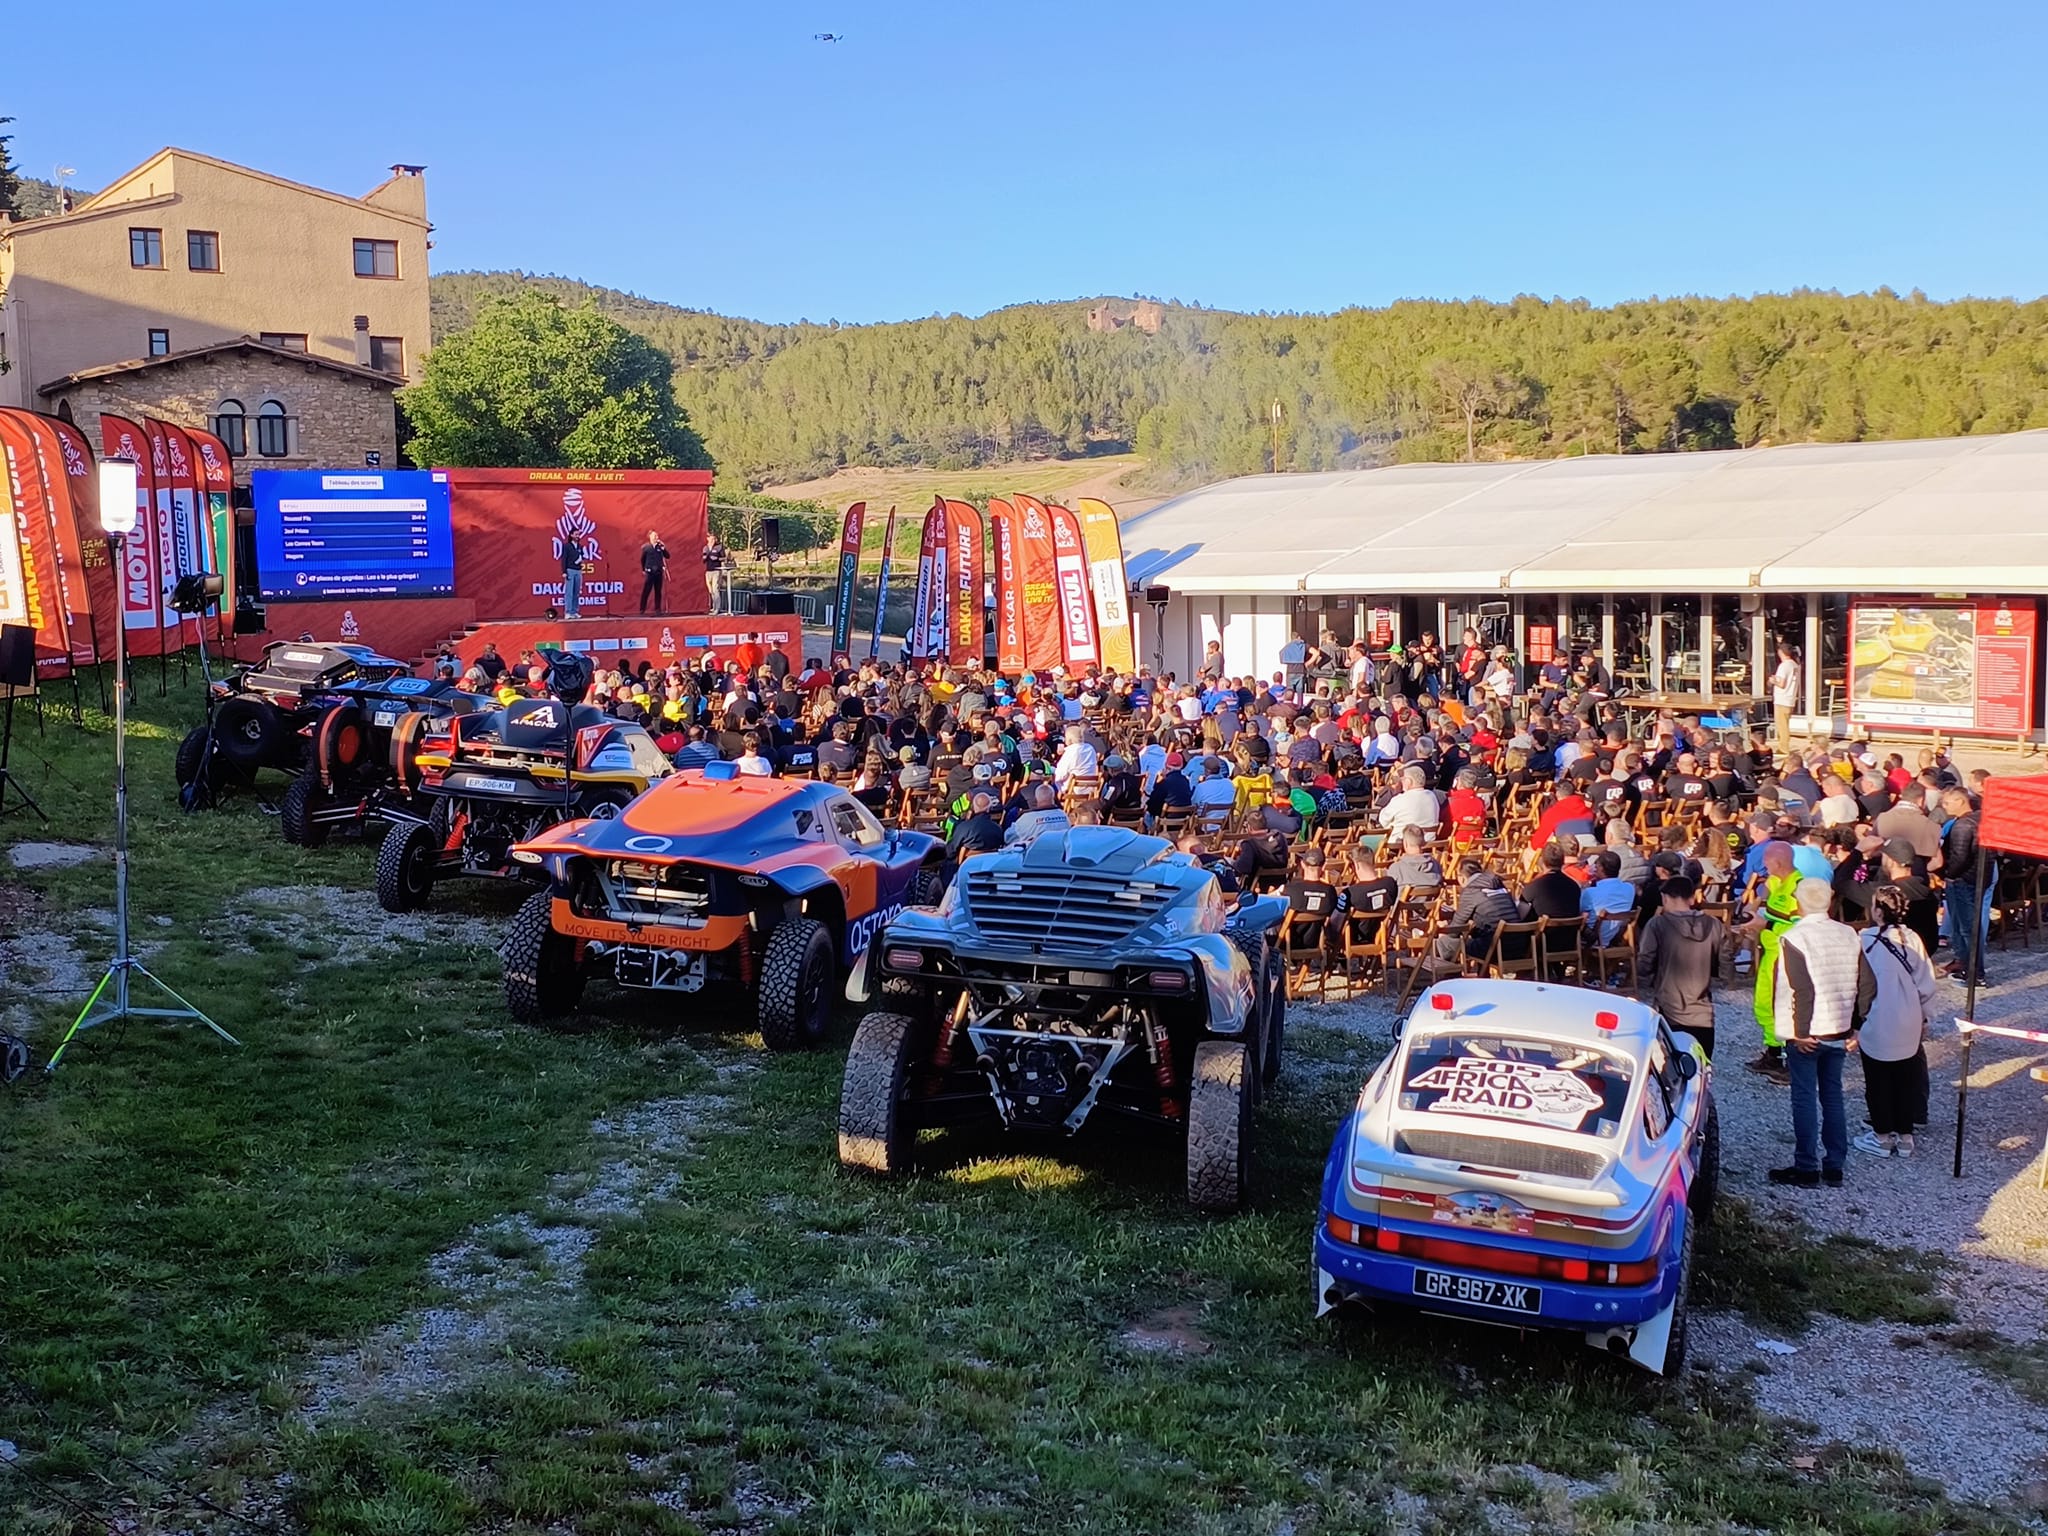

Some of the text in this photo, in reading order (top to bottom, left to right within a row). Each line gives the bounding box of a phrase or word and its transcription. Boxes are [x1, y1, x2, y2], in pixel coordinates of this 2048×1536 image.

[529, 472, 563, 480] DREAM.
[566, 472, 592, 480] DARE.
[595, 472, 614, 480] LIVE
[586, 582, 624, 594] TOUR
[958, 524, 972, 646] DAKARFUTURE
[1000, 517, 1017, 646] DAKAR CLASSIC
[1063, 572, 1088, 643] MOTUL
[564, 924, 603, 939] MOVE.
[629, 931, 665, 946] YOUR
[669, 935, 711, 949] RIGHT
[1415, 1069, 1533, 1095] AFRICA
[1459, 1060, 1541, 1079] 205
[1451, 1087, 1534, 1110] RAID
